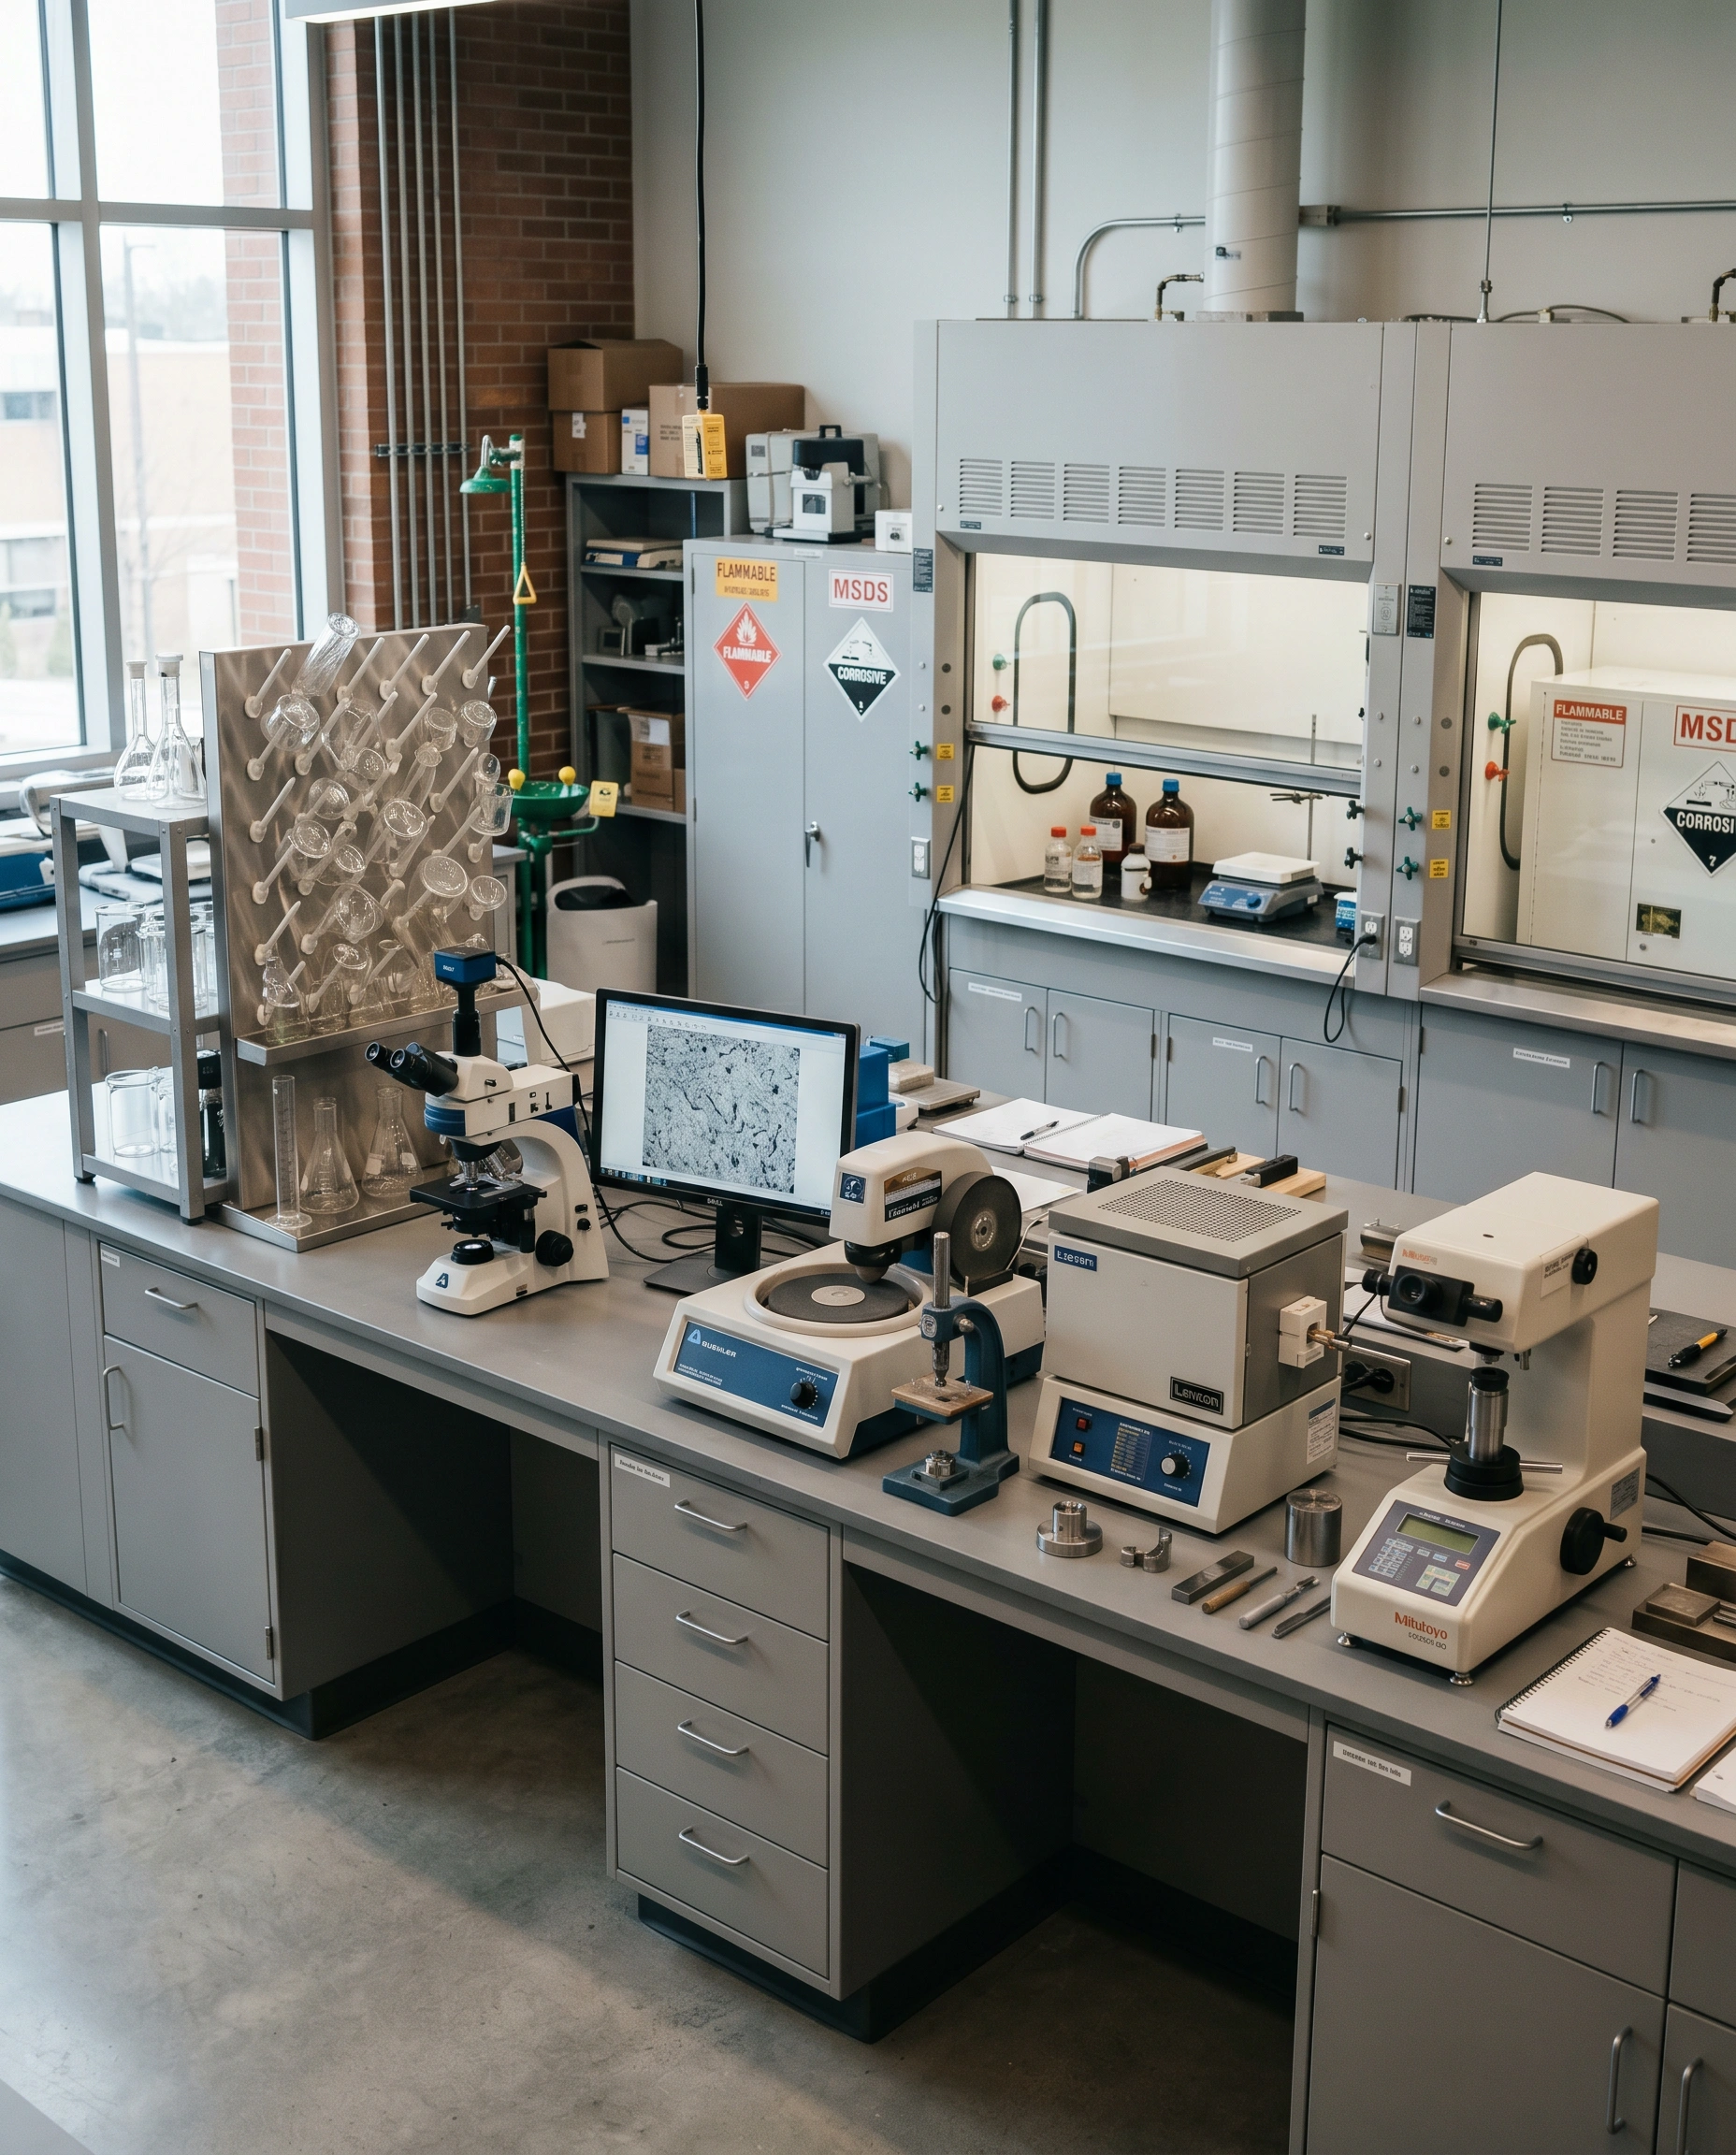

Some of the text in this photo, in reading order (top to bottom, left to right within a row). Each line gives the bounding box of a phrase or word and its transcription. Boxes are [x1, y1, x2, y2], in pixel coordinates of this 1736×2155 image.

[717, 562, 776, 582] FLAMMABLE
[834, 578, 889, 603] MSDS
[837, 666, 887, 685] CORROSIVE
[1555, 703, 1624, 721] FLAMMABLE
[1395, 1612, 1448, 1640] Mitutoyo
